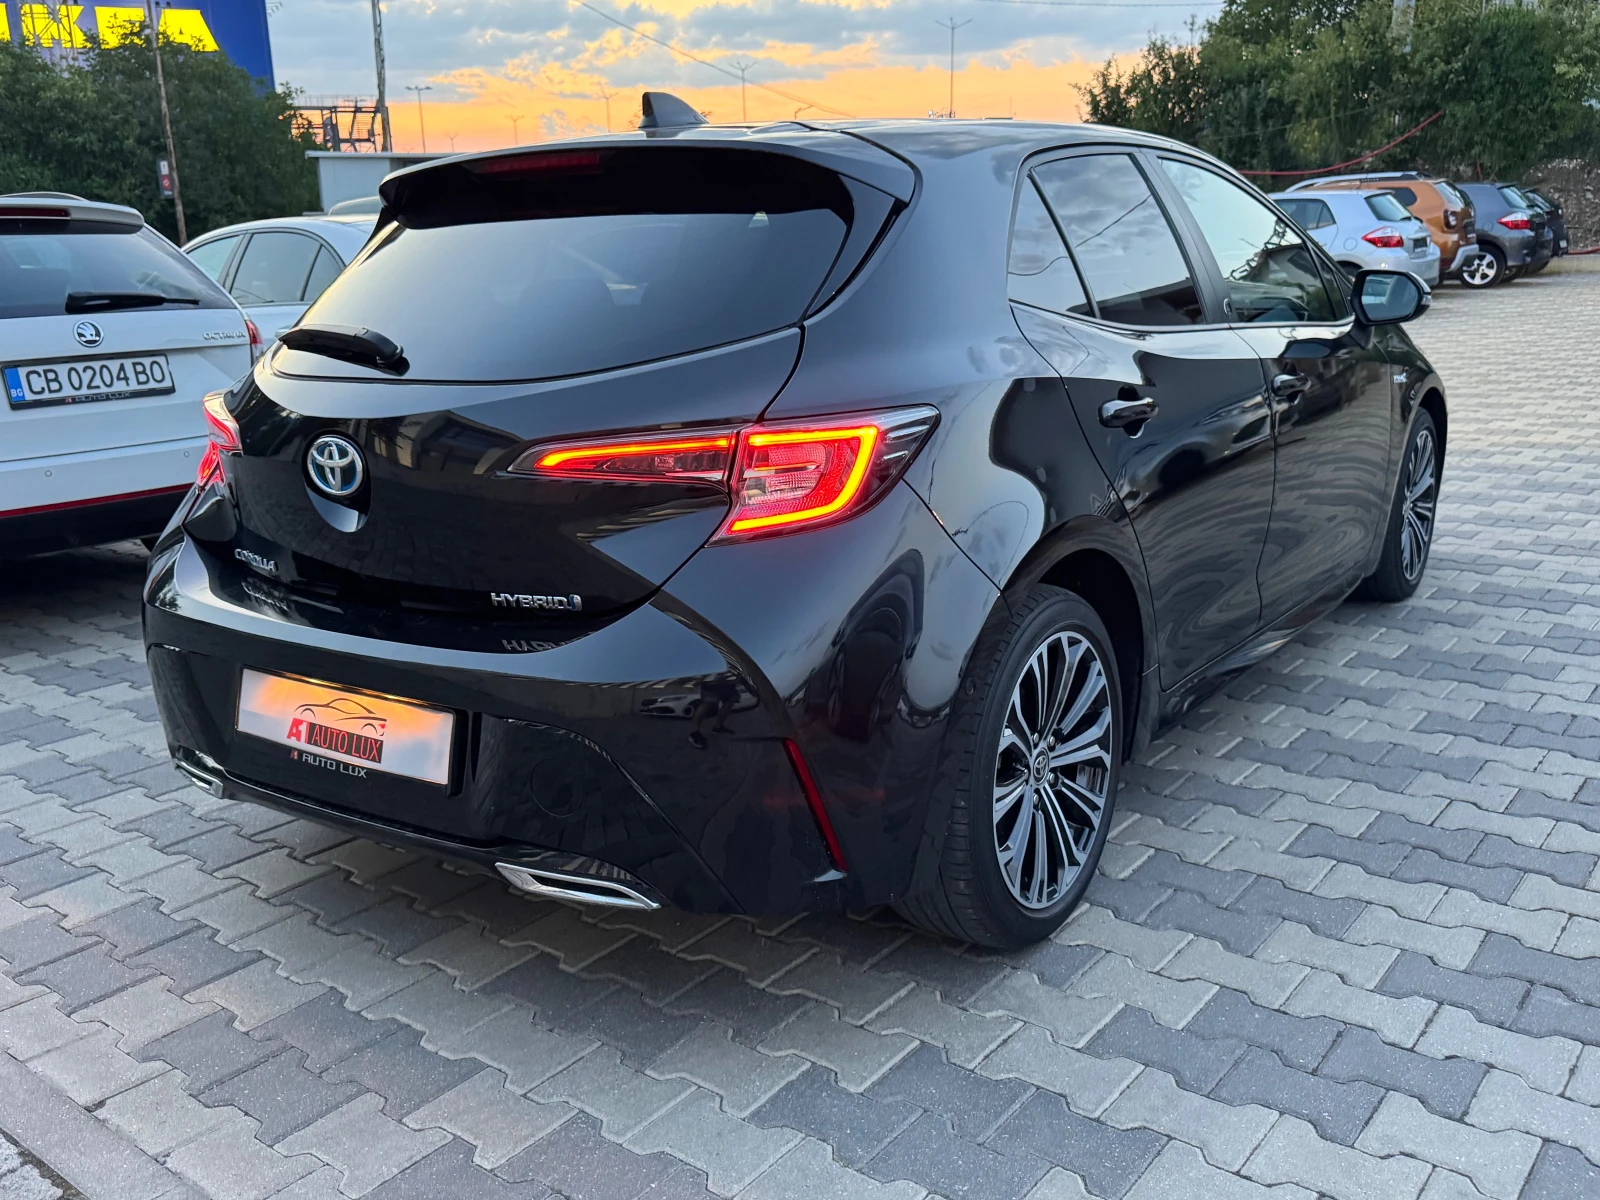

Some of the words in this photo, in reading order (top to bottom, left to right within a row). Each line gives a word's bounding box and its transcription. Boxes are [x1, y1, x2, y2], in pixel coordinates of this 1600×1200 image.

[203, 331, 246, 341] OCTAVIA
[25, 368, 63, 395] CB
[67, 362, 130, 391] 0204
[131, 360, 166, 386] BO
[10, 388, 24, 398] BG
[490, 592, 569, 609] HYBRID
[286, 717, 310, 744] A1
[311, 724, 348, 753] AUTO
[351, 734, 381, 762] LUX
[302, 752, 336, 770] AUTO
[340, 763, 367, 778] LUX
